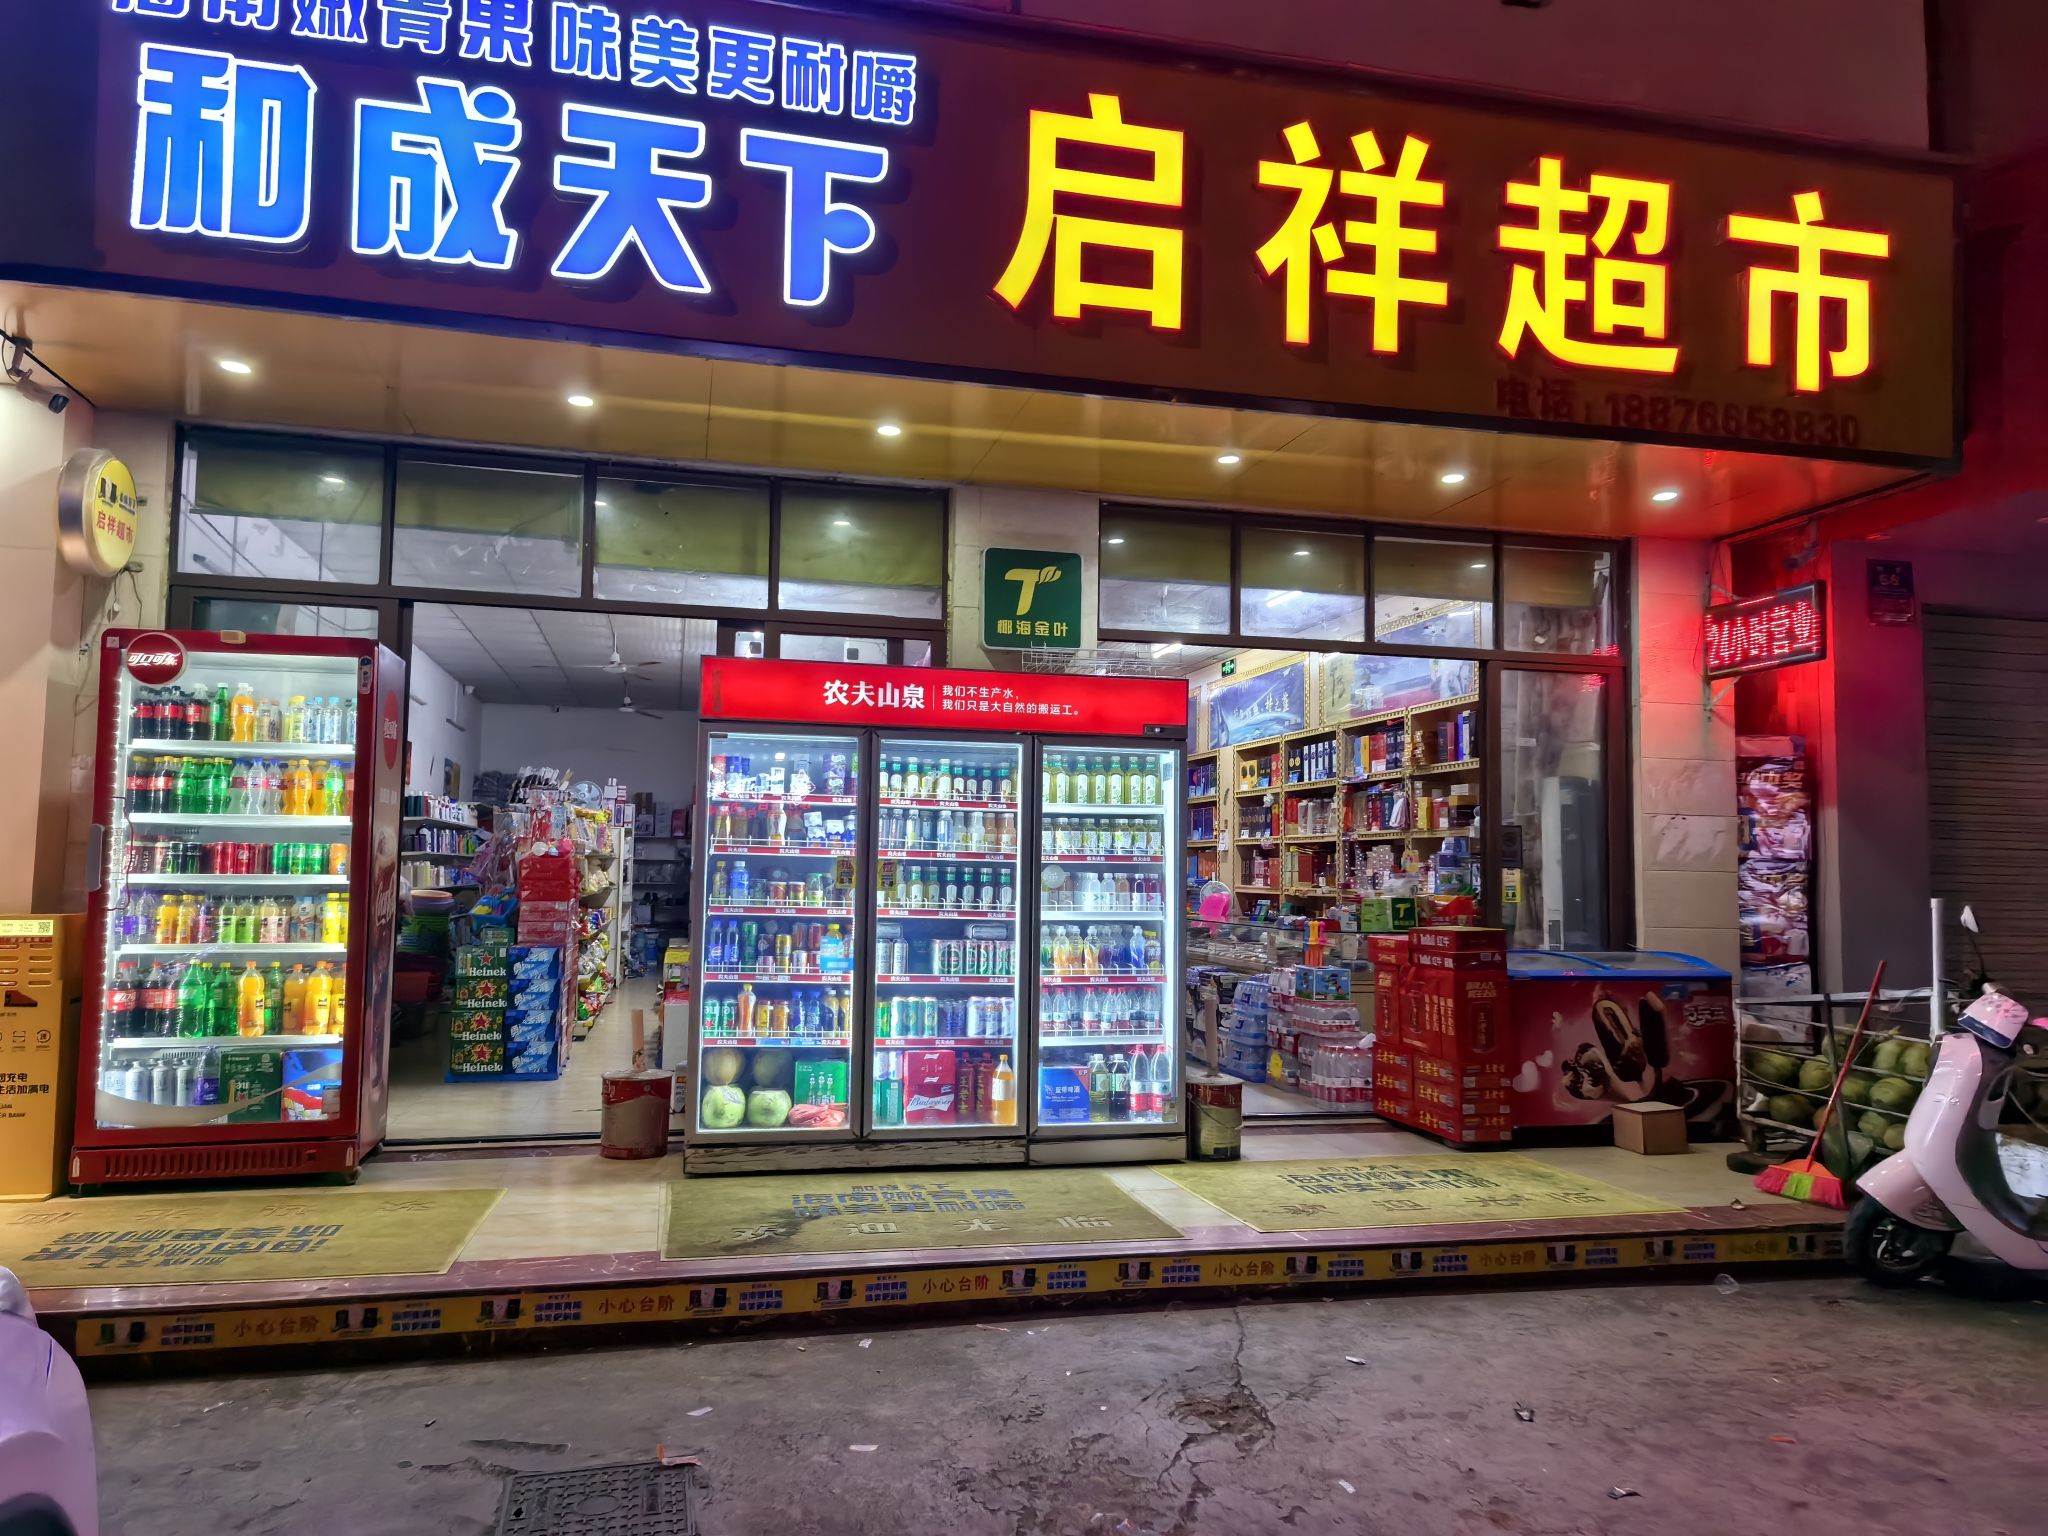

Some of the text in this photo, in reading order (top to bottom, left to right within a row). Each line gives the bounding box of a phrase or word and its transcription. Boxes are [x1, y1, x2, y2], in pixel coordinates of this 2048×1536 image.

[113, 0, 917, 126] 嫩青果味美更耐嚼
[132, 43, 890, 307] 和成天下
[991, 93, 1890, 392] 启祥超市
[997, 619, 1069, 637] 椰海金叶
[823, 680, 925, 709] 农夫山泉
[942, 699, 1080, 717] 我们只是大自然的搬运工。
[1213, 1261, 1275, 1278] 小心台阶
[922, 1275, 990, 1295] 小心台阶
[599, 1295, 675, 1314] 小心台阶
[234, 1315, 319, 1337] 小心台阶
